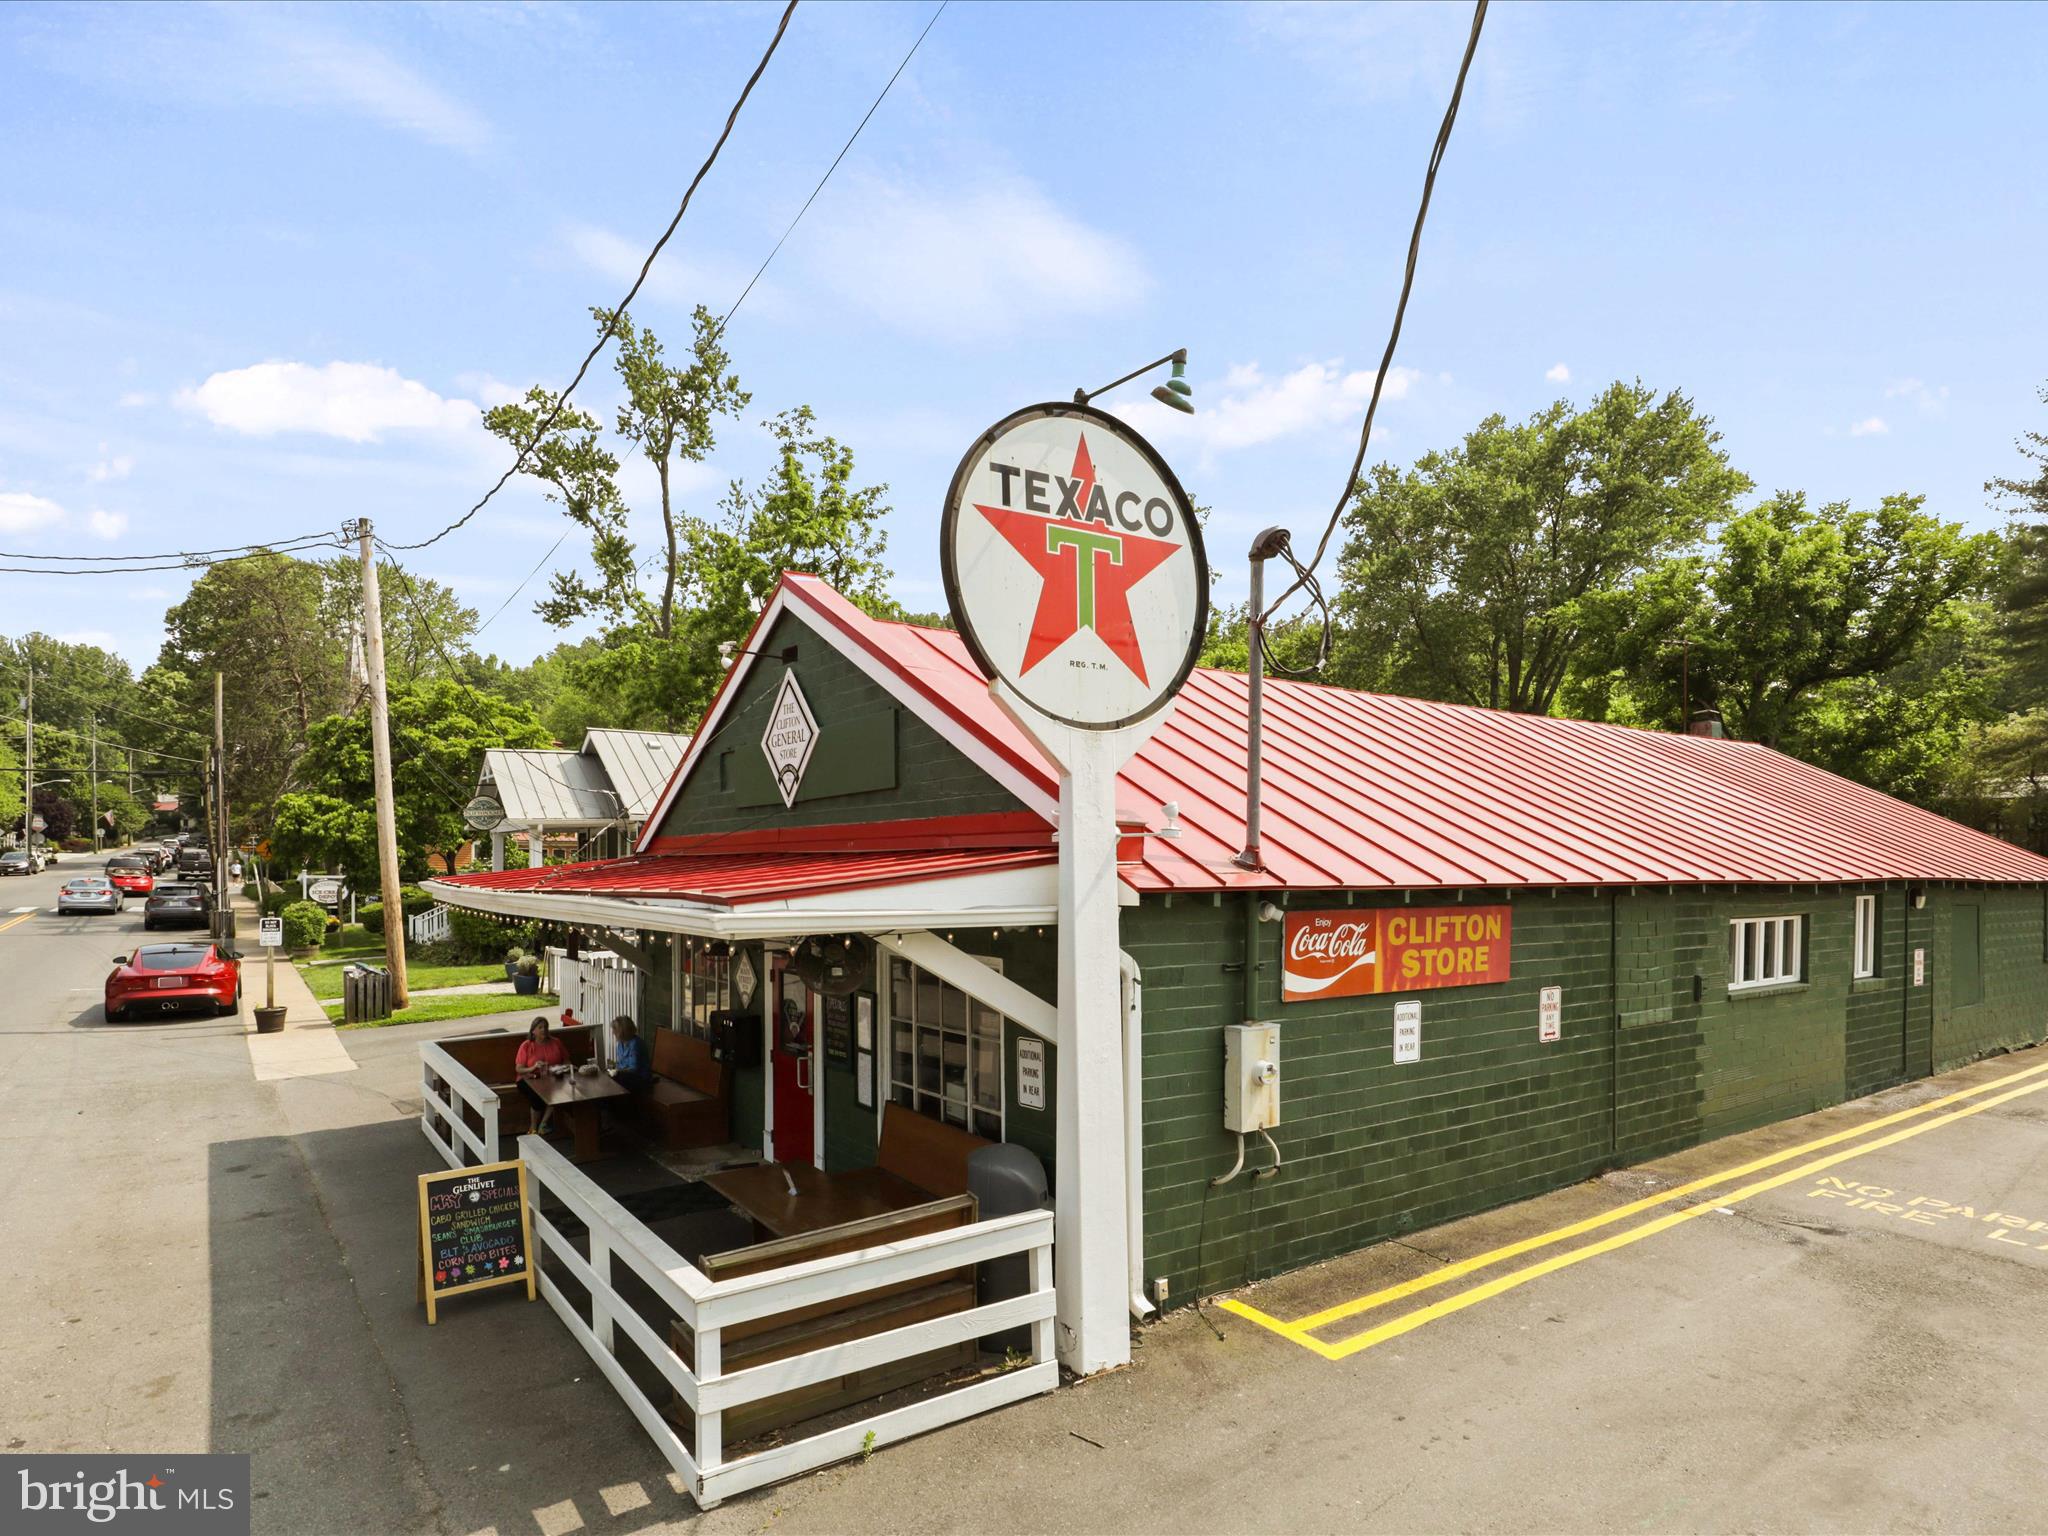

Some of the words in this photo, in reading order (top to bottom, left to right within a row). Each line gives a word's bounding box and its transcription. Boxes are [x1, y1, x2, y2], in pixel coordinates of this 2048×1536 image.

[989, 462, 1174, 537] TEXACO
[1069, 660, 1089, 670] REG.
[783, 703, 795, 715] THE
[776, 716, 800, 731] CLIFTON
[771, 729, 806, 748] GENERAL
[779, 748, 797, 760] STORE
[1315, 918, 1332, 927] Enjoy
[1387, 914, 1501, 946] CLIFTON
[1291, 922, 1369, 960] Coca-Cola
[1401, 946, 1489, 978] STORE
[1546, 992, 1554, 1001] NO
[1541, 1001, 1559, 1012] PARKING
[1397, 1011, 1418, 1021] ADDITIONAL
[1546, 1013, 1554, 1021] ANY
[1400, 1027, 1415, 1036] PARKING
[1400, 1043, 1404, 1052] IN
[1404, 1041, 1415, 1051] REAR
[1020, 1049, 1042, 1062] ADDITIONAL
[1022, 1066, 1039, 1079] PARKING
[1023, 1084, 1028, 1094] IN
[1028, 1085, 1040, 1096] REAR
[452, 1180, 496, 1194] GLENLIVET
[1816, 1176, 1895, 1198] NO
[430, 1192, 463, 1211] MAY
[481, 1185, 519, 1201] SPECIALS
[431, 1213, 452, 1226] CABO
[455, 1207, 487, 1221] GRILLED
[489, 1200, 519, 1214] CHICKEN
[1806, 1188, 1949, 1226] FIRE
[451, 1216, 491, 1231] SANDWICH
[463, 1219, 518, 1236] SMASHBURGER
[460, 1234, 483, 1245] CLUB
[440, 1246, 459, 1259] BLT
[470, 1235, 514, 1254] AVOCADO
[438, 1256, 465, 1270] CORN
[468, 1252, 487, 1263] DOG
[489, 1244, 518, 1259] BITES
